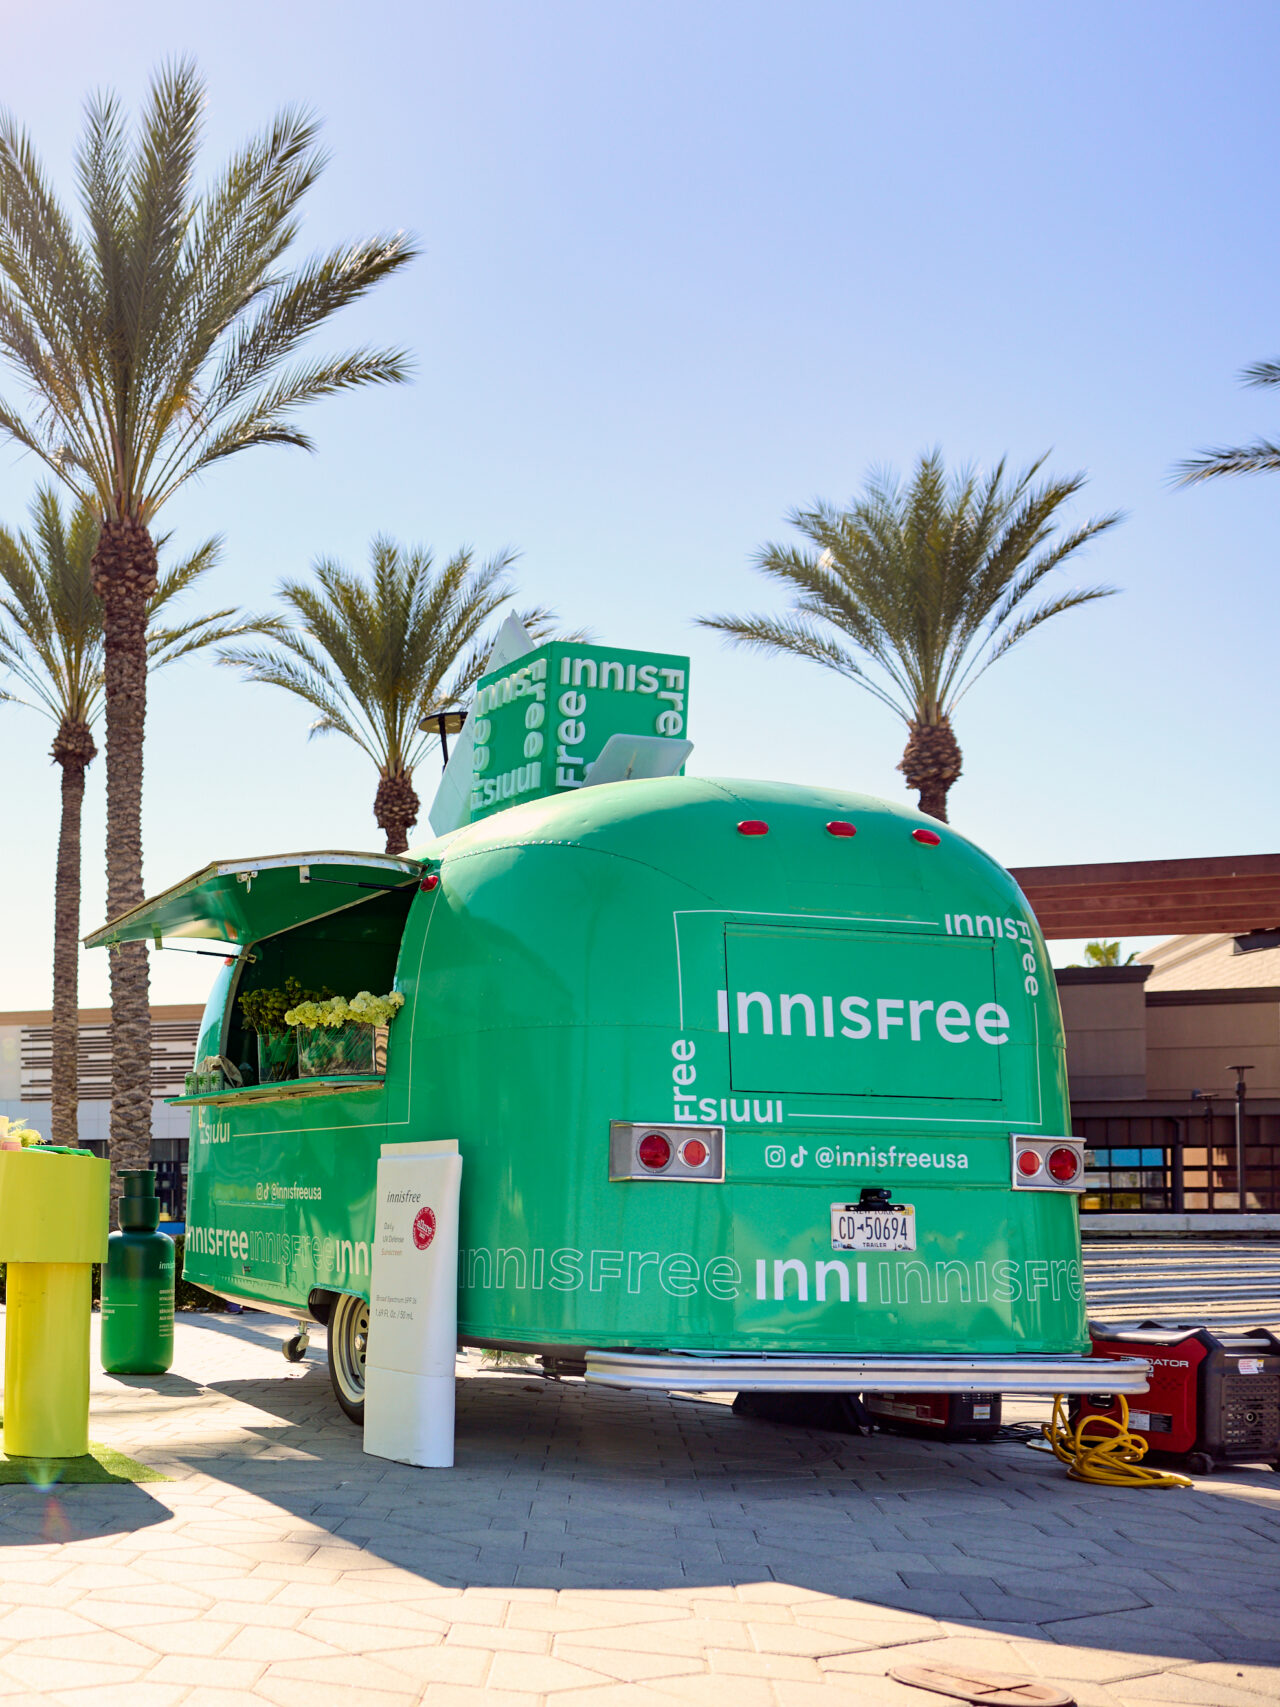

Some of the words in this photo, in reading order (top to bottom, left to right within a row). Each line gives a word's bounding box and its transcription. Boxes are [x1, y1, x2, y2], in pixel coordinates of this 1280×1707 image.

[655, 668, 686, 737] Fre
[815, 1144, 969, 1169] @innisfreeusa
[386, 1190, 421, 1203] innisfree
